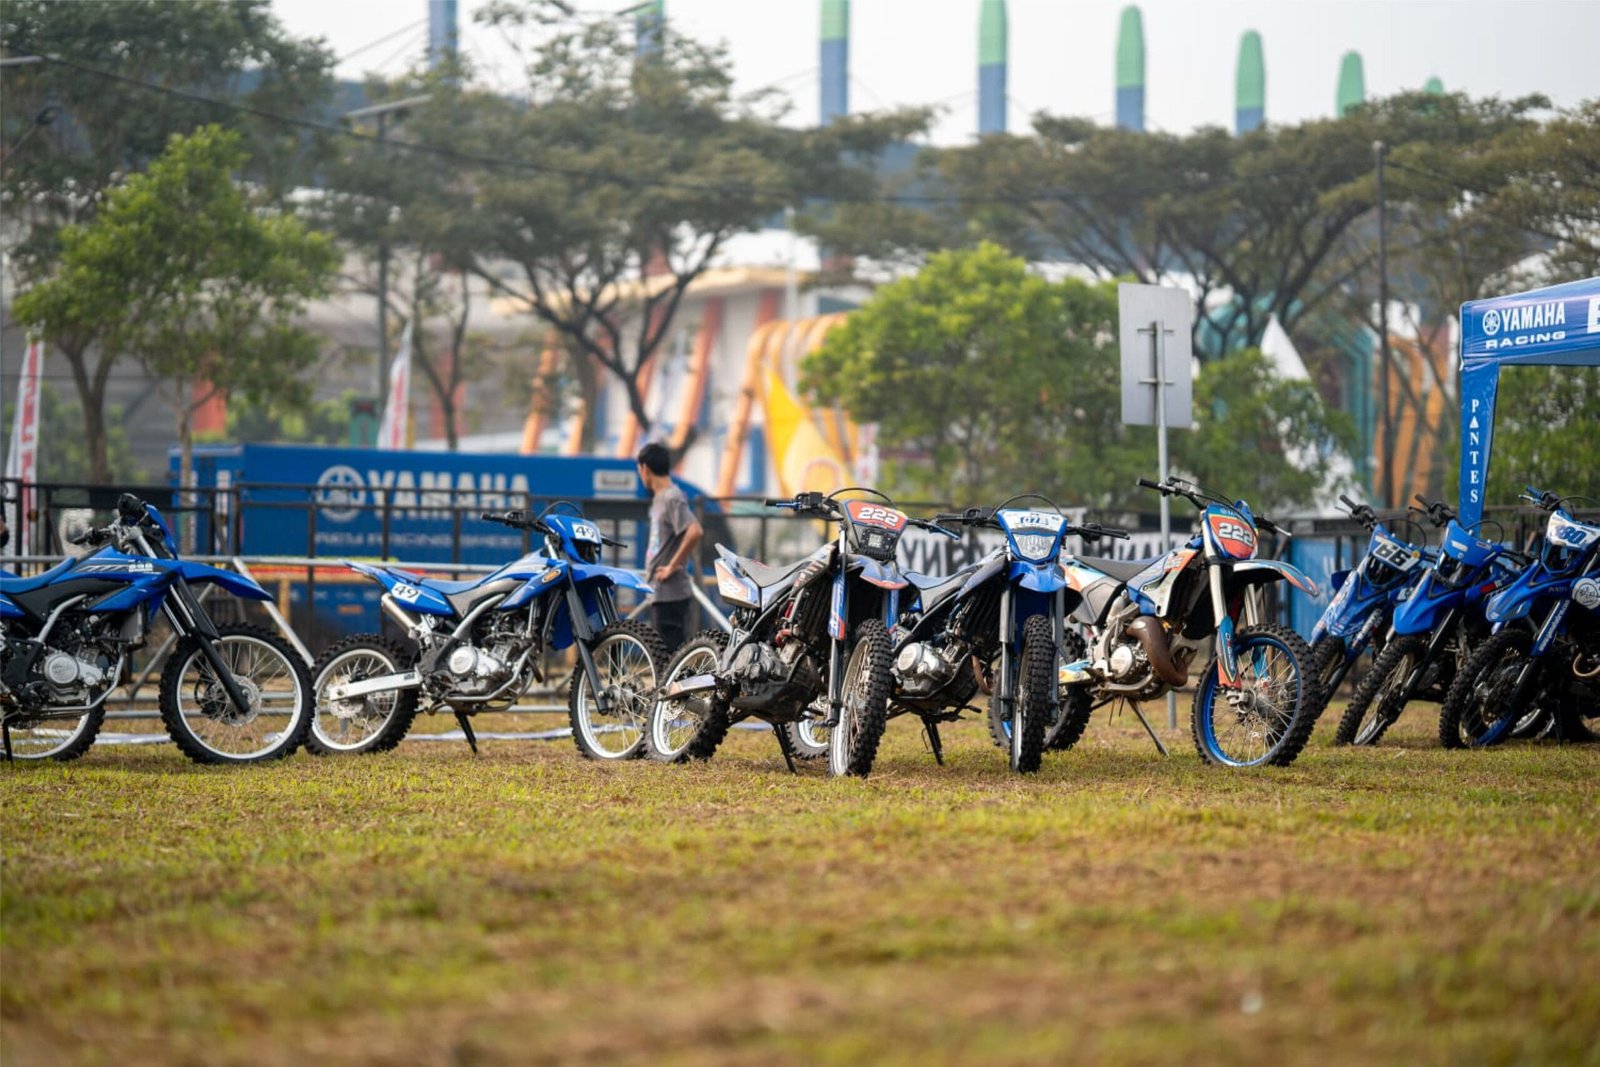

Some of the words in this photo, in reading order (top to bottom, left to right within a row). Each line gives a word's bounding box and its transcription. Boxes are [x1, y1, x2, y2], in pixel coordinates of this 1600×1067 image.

[1501, 302, 1566, 332] YAMAHA
[1485, 331, 1566, 350] RACING
[1469, 399, 1479, 503] PANTES
[368, 469, 529, 520] YAMAHA
[857, 507, 899, 526] 222
[1218, 521, 1254, 547] 222
[393, 585, 420, 599] 49
